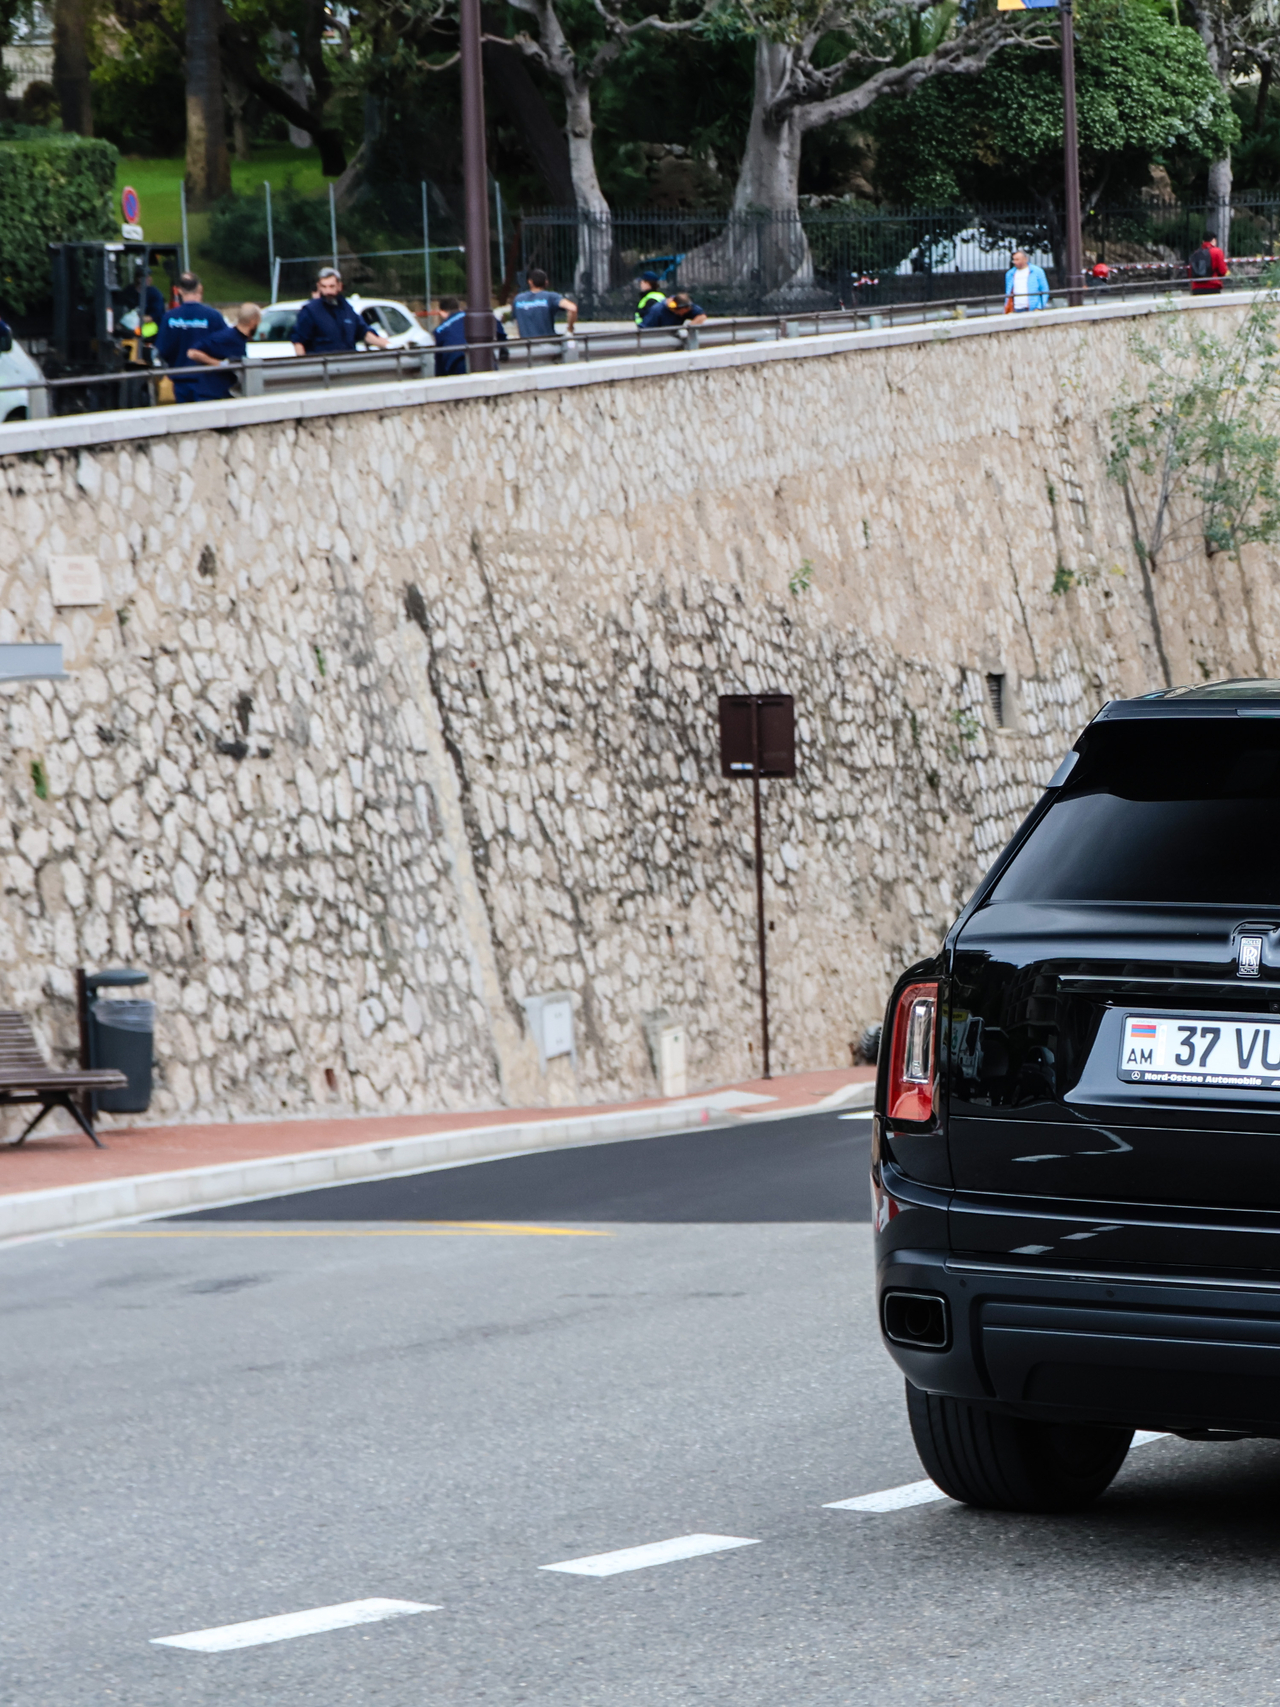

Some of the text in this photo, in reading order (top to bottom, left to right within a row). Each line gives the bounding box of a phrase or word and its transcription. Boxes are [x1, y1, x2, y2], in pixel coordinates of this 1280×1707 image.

[1175, 1026, 1221, 1067] 37
[1126, 1048, 1153, 1065] AM
[1144, 1072, 1262, 1085] Nord-Ostsee Automobile
